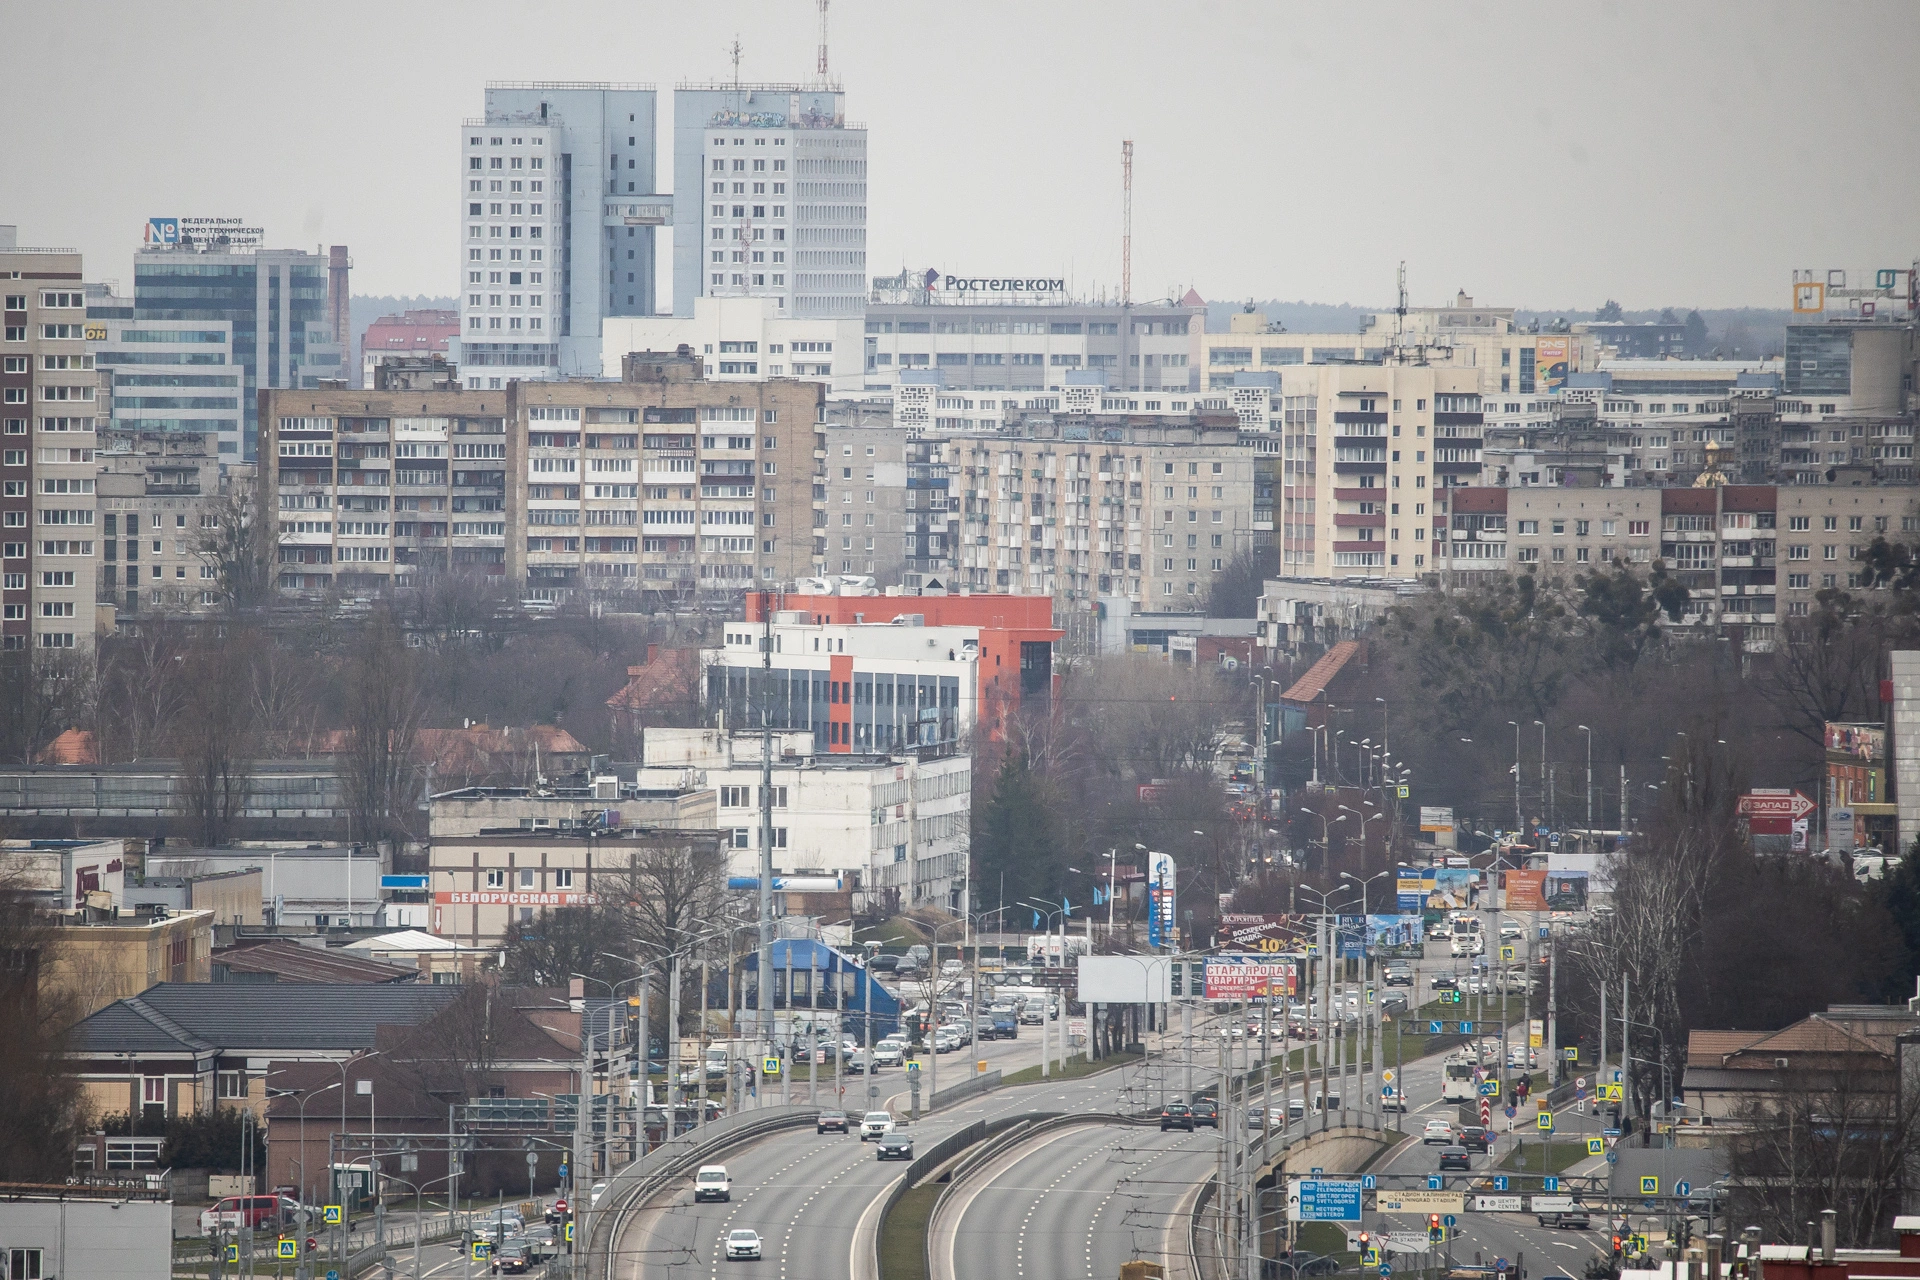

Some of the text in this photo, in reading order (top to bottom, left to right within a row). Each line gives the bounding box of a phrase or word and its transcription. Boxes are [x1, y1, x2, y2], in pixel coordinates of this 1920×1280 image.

[945, 275, 1064, 291] Ростелеком
[1539, 340, 1567, 348] DNS
[1792, 801, 1808, 811] 39
[451, 893, 559, 903] БЕЛОРУССКАЯ
[1232, 922, 1277, 937] ВОСКРЕСНАЯ
[1234, 933, 1262, 943] СКИДКА
[1207, 966, 1241, 975] СТАРТ
[1207, 976, 1257, 985] КВАРТИРЫ
